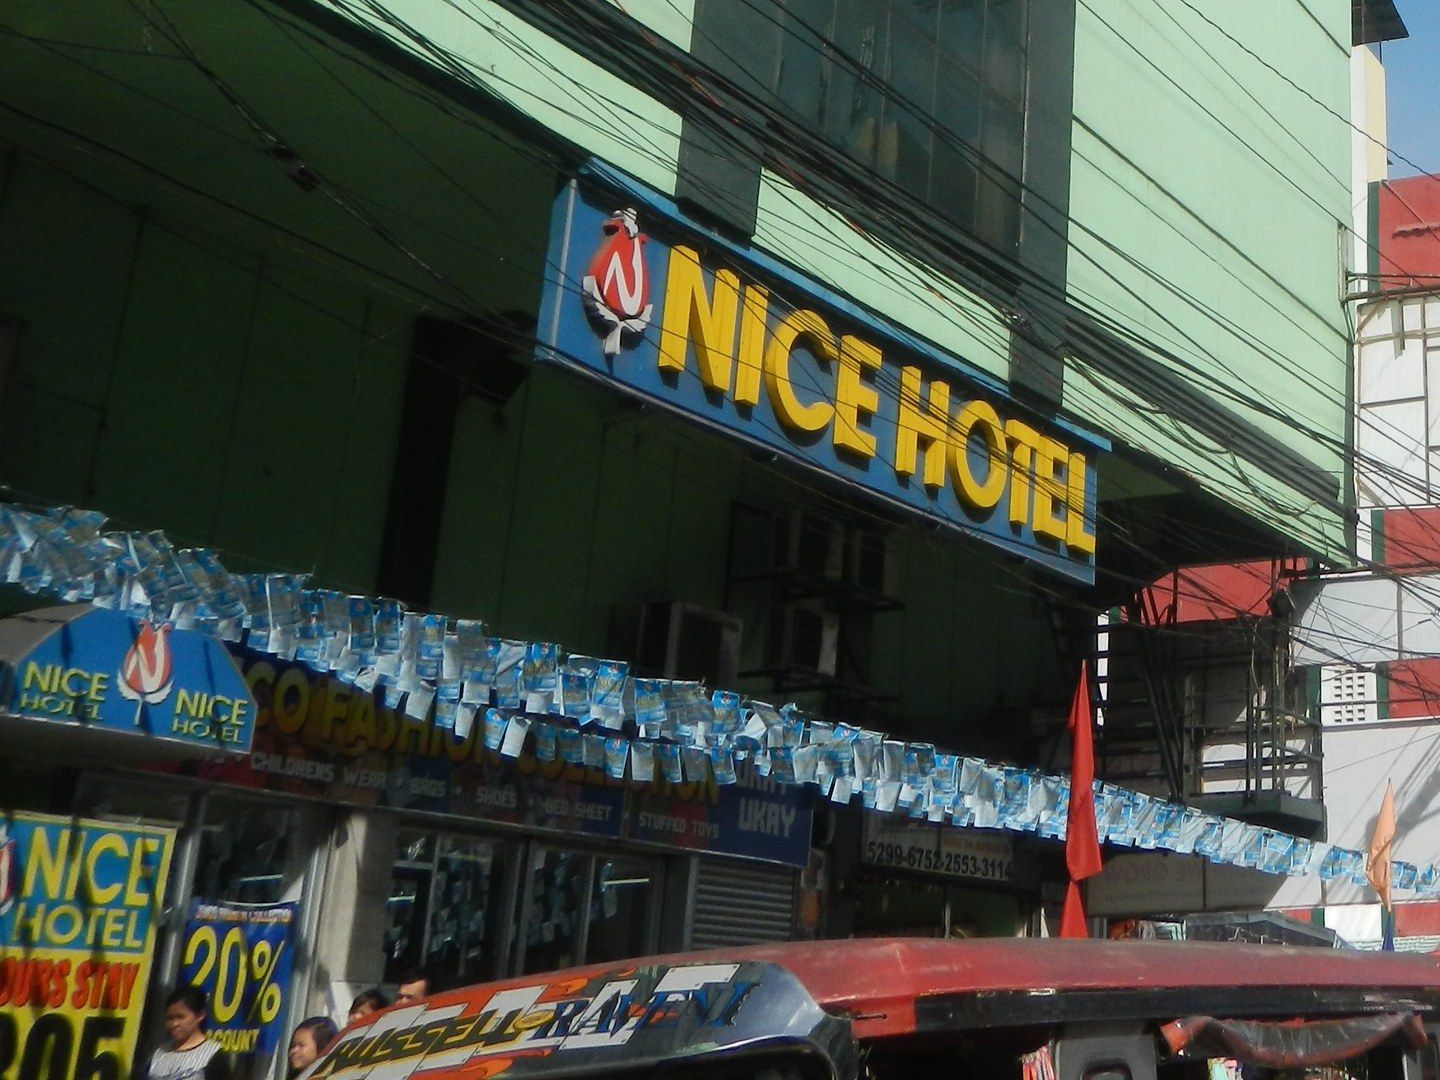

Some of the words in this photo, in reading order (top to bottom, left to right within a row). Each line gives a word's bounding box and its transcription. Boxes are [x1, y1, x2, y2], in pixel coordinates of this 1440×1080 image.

[658, 245, 883, 458] NICE
[895, 365, 1096, 555] HOTEL
[22, 660, 110, 702] NICE
[175, 688, 248, 726] NICE
[739, 797, 796, 838] UKAY
[22, 826, 160, 907] NICE
[12, 901, 146, 948] HOTEL
[72, 960, 141, 1010] STAY
[184, 925, 287, 1024] 20%
[0, 1013, 128, 1080] 05
